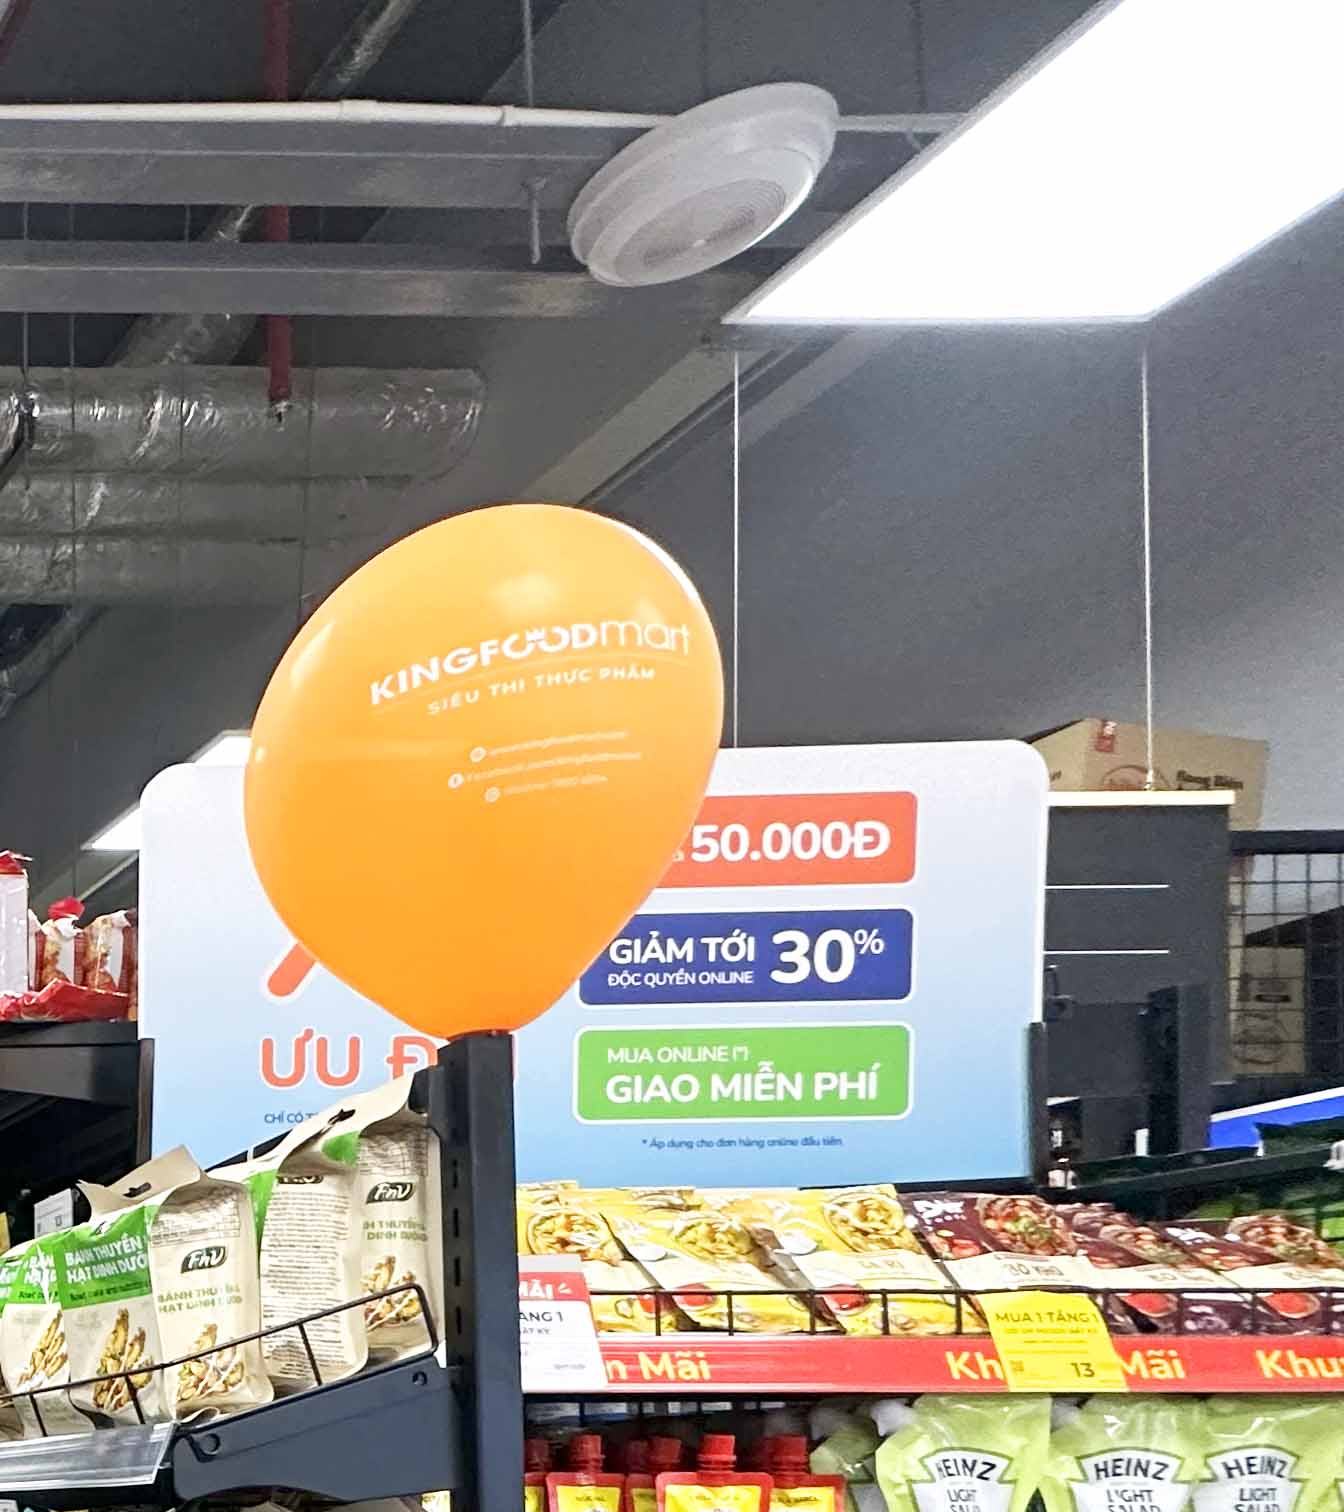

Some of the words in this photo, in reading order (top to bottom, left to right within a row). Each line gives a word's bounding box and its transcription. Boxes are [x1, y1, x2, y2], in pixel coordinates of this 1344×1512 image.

[370, 620, 690, 705] KINGFOODmart
[608, 930, 695, 965] GIẢM
[701, 929, 755, 963] TỚI
[769, 928, 886, 985] 30%
[608, 969, 641, 988] ĐỘC
[699, 970, 754, 986] ONLINE
[261, 1028, 361, 1088] ƯU
[607, 1047, 653, 1064] MUA
[657, 1045, 728, 1063] ONLINE
[605, 1073, 701, 1104] GIAO
[710, 1060, 803, 1102] MIỄN
[814, 1061, 882, 1102] PHÍ
[372, 1181, 414, 1202] FnV
[1070, 1362, 1095, 1379] 13
[1094, 1456, 1170, 1481] HEINZ
[1226, 1454, 1287, 1480] HEINZ
